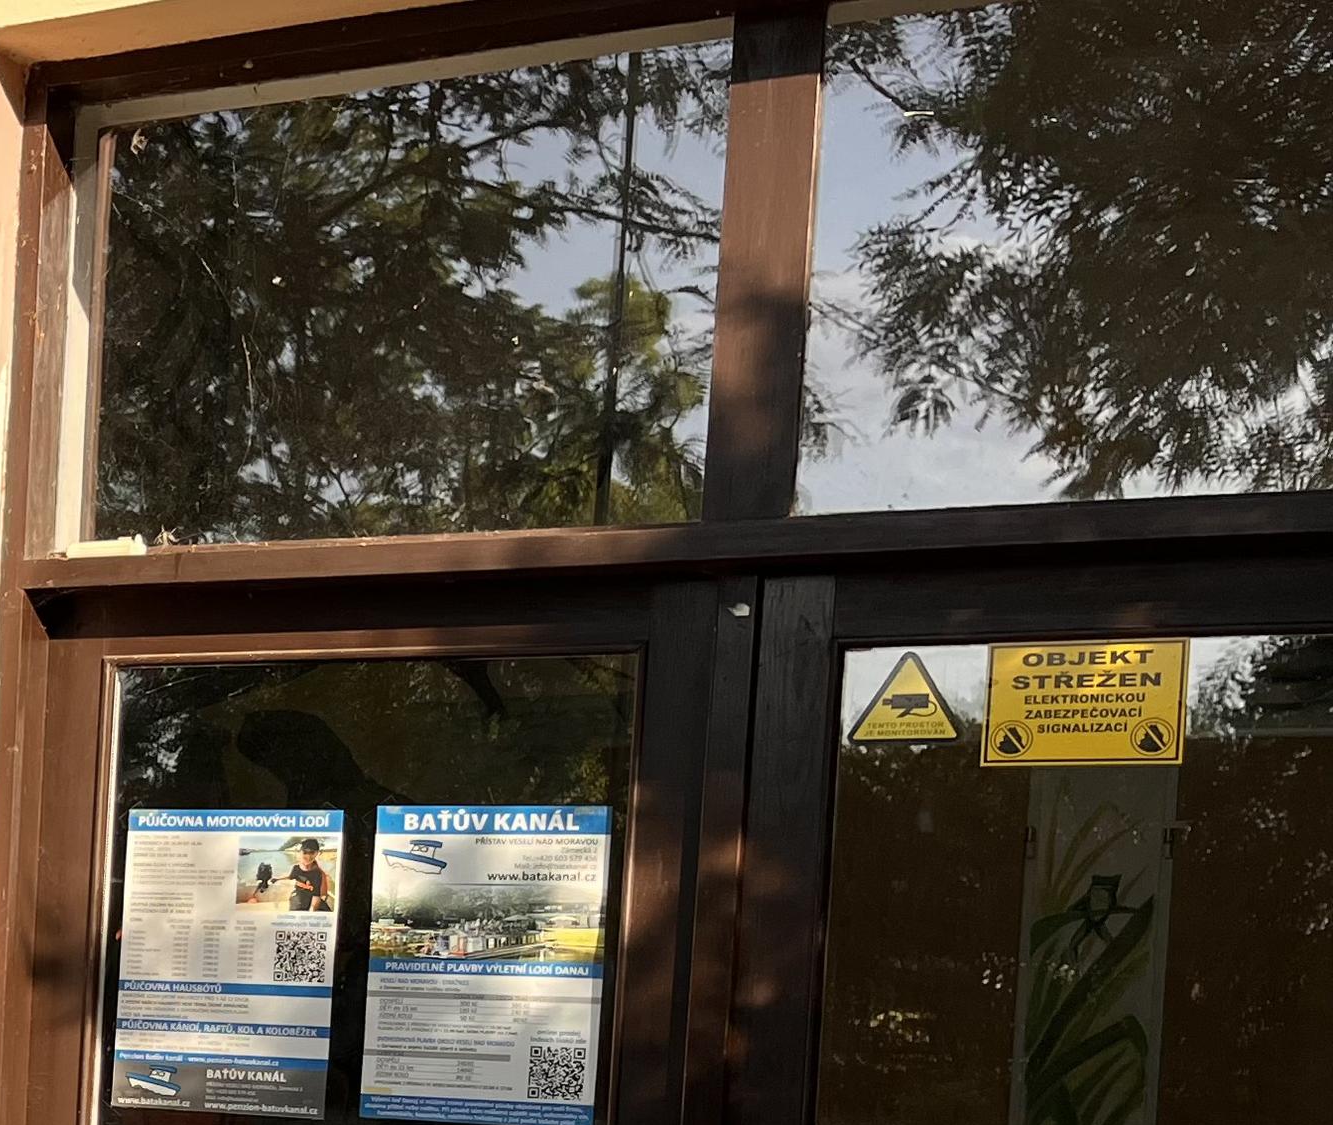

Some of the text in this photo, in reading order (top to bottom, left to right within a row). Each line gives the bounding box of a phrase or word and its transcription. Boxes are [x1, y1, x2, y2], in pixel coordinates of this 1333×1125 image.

[1022, 649, 1155, 667] OBJEKT
[1011, 670, 1163, 690] STŘEŽEN
[1024, 692, 1146, 705] ELEKTRONICKOU
[1024, 706, 1143, 719] ZABEZPEČOVACÍ
[899, 721, 945, 729] PROSTOR
[1037, 721, 1129, 735] SIGNALIZACÍ
[880, 728, 946, 737] MONITOROVÁN
[137, 813, 330, 828] PŮJČOVNA MOTOROVÝCH LODÍ
[404, 808, 580, 831] BAŤŮV KANÁL
[475, 836, 507, 845] PŘÍSTAV
[508, 836, 533, 845] VESELÍ
[487, 871, 597, 882] www.batakanal.cz
[385, 960, 589, 975] PRAVIDELNÉ PLAVBY VÝLETNÍ LODÍ DANAJ
[124, 980, 222, 994] PŮJČOVNA HAUSBÓTŮ
[121, 1019, 318, 1038] PŮJČOVNA KÁNOÍ, RAFTŮ, KOL A KOLOBĚŽEK
[206, 1068, 287, 1083] BAŤŮV KANÁL
